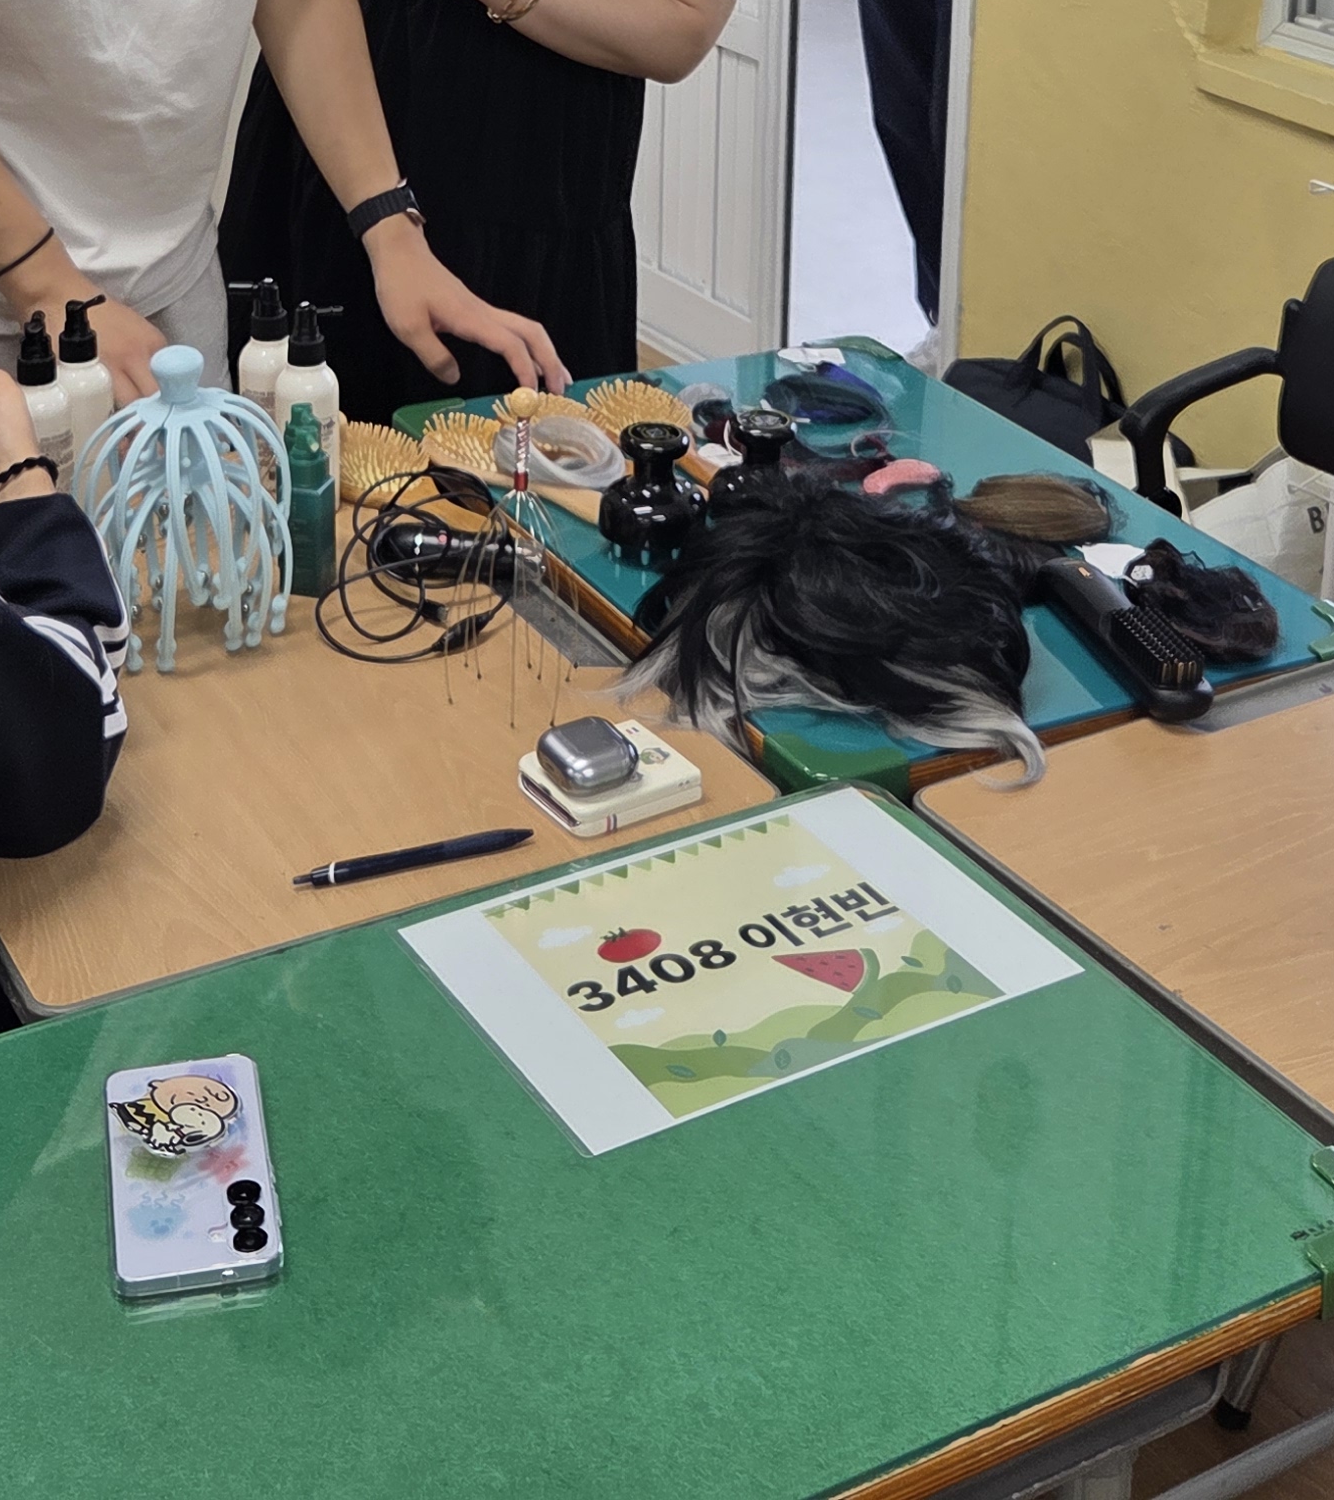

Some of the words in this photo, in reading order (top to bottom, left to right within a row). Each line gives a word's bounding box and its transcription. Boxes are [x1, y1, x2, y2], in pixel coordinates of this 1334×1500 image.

[1307, 502, 1329, 534] B
[566, 938, 738, 1013] 3408
[738, 881, 901, 948] 이현빈
